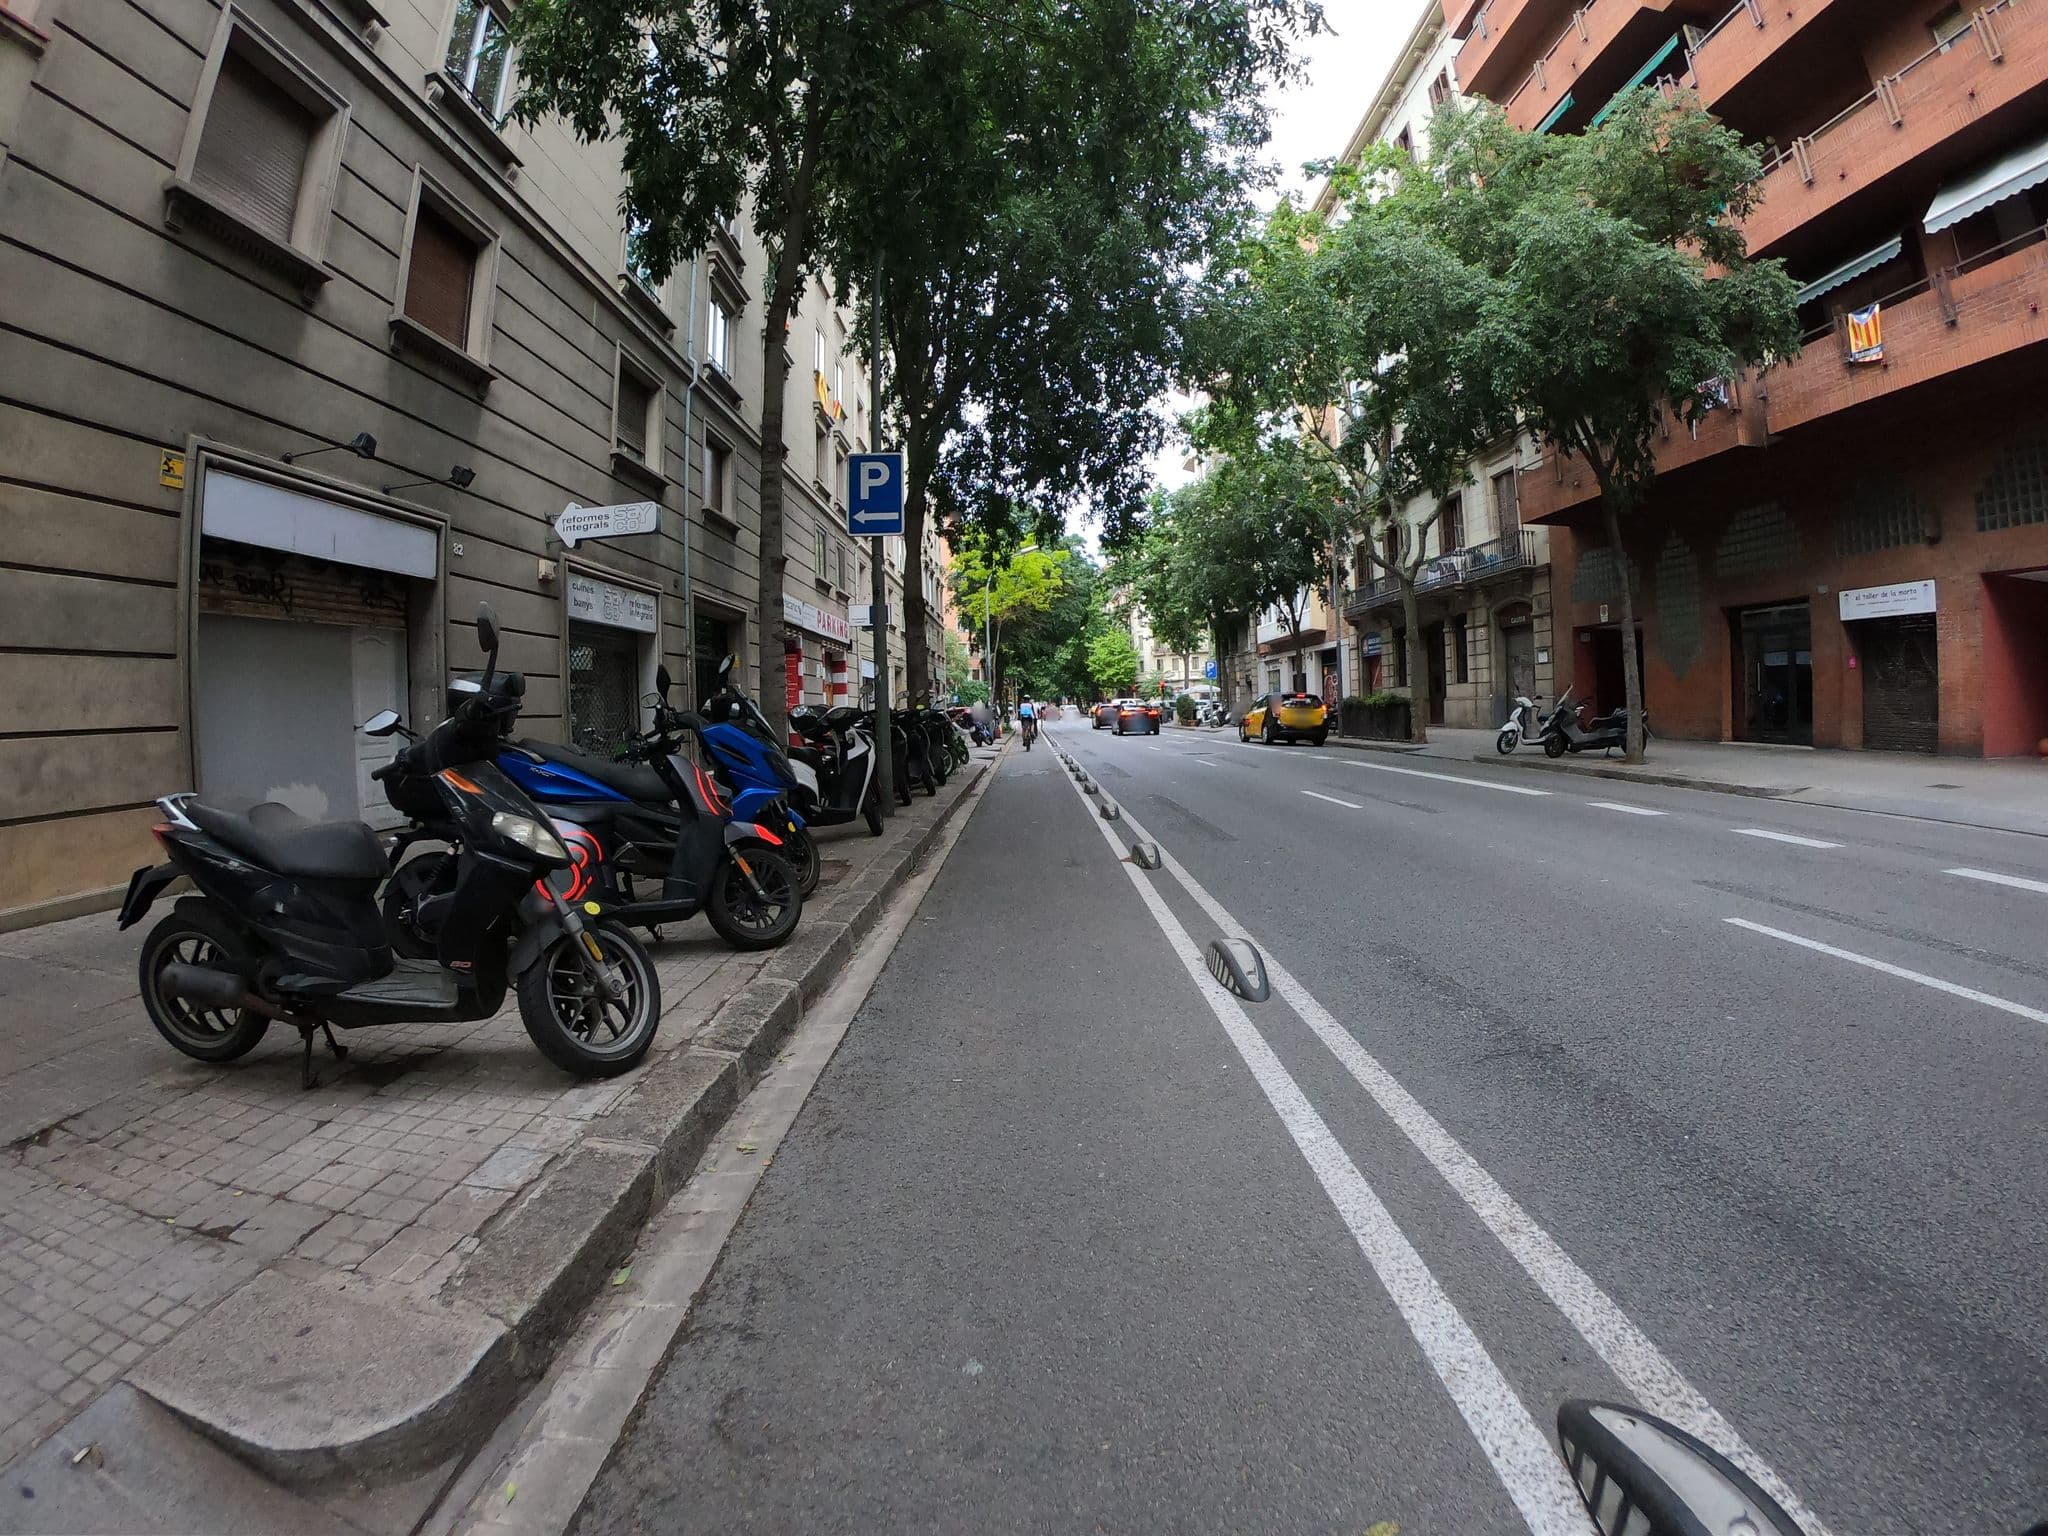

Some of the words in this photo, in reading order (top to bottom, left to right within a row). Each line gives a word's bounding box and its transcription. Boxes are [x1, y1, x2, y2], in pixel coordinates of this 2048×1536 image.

[860, 461, 890, 500] P
[562, 513, 610, 524] reformes
[562, 521, 610, 532] integrals
[453, 542, 464, 556] 82
[572, 582, 594, 595] cuines
[573, 596, 593, 611] banys
[816, 609, 848, 639] PARKING
[1207, 662, 1215, 672] P
